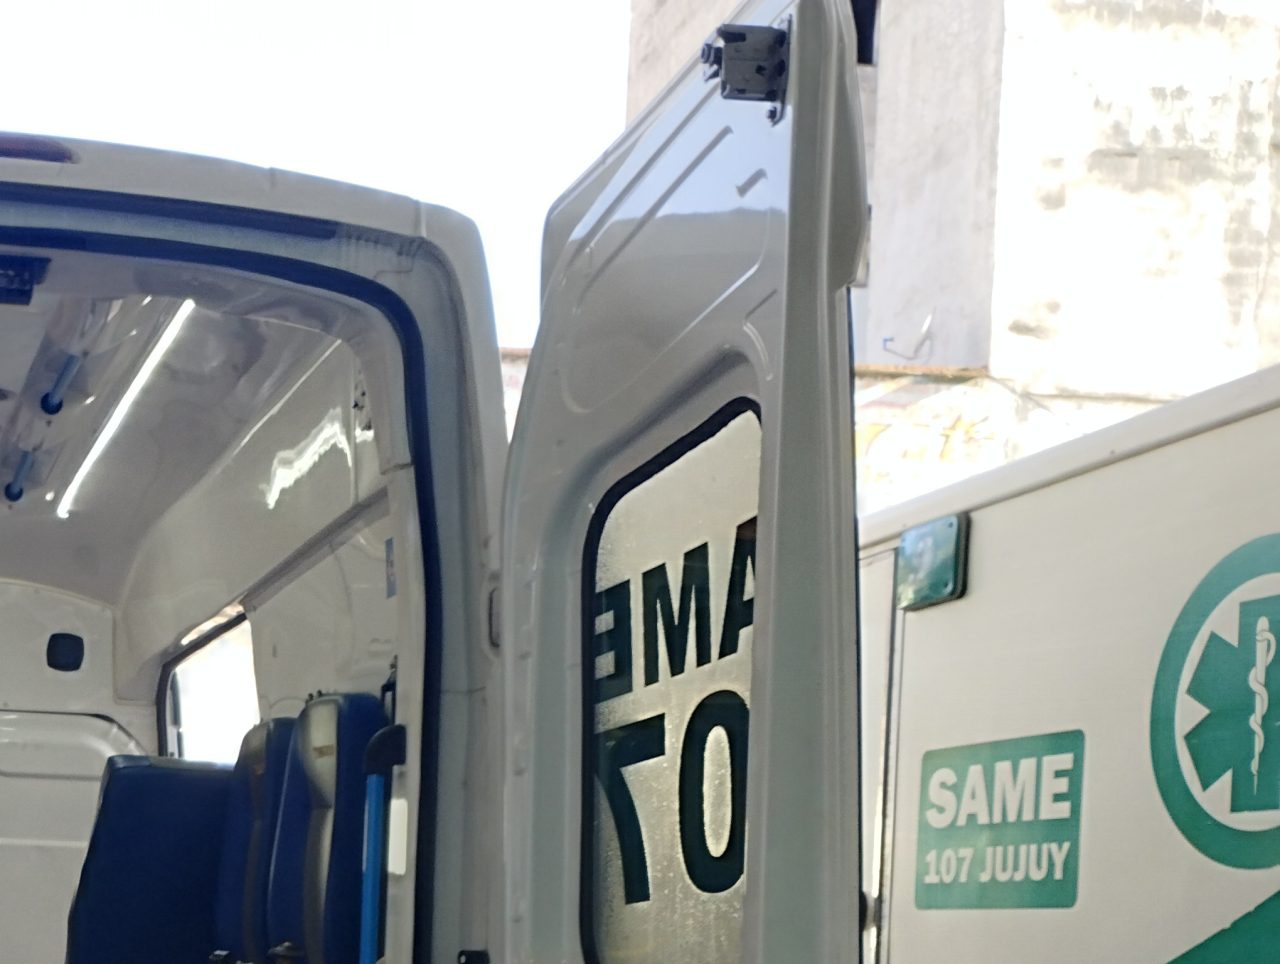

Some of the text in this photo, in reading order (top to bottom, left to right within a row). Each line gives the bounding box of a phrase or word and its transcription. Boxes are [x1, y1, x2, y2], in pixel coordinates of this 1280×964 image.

[925, 752, 1074, 829] SAME
[923, 841, 1071, 884] 107 JUJUY
